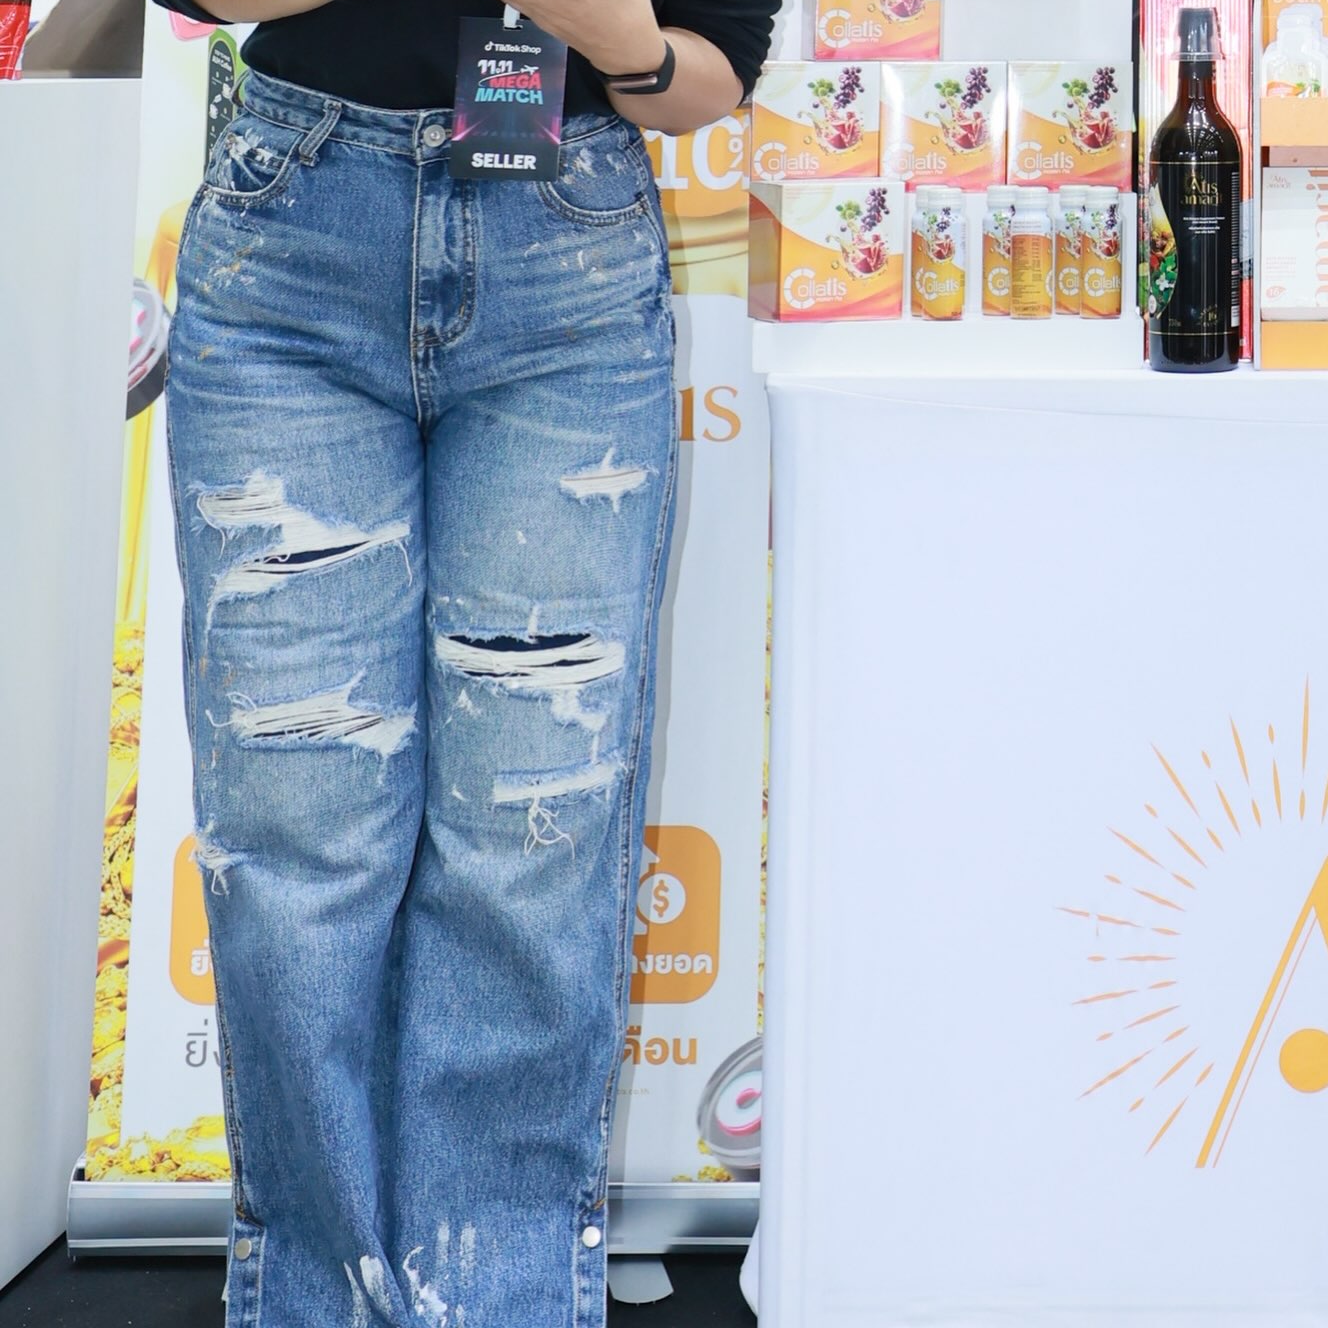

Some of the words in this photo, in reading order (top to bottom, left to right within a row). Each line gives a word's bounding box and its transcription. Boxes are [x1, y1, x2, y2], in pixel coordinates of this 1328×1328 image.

[521, 44, 542, 55] Shop
[477, 59, 514, 74] 11.11
[488, 72, 542, 89] MEGA
[474, 88, 544, 104] MATCH
[471, 152, 537, 170] SELLER
